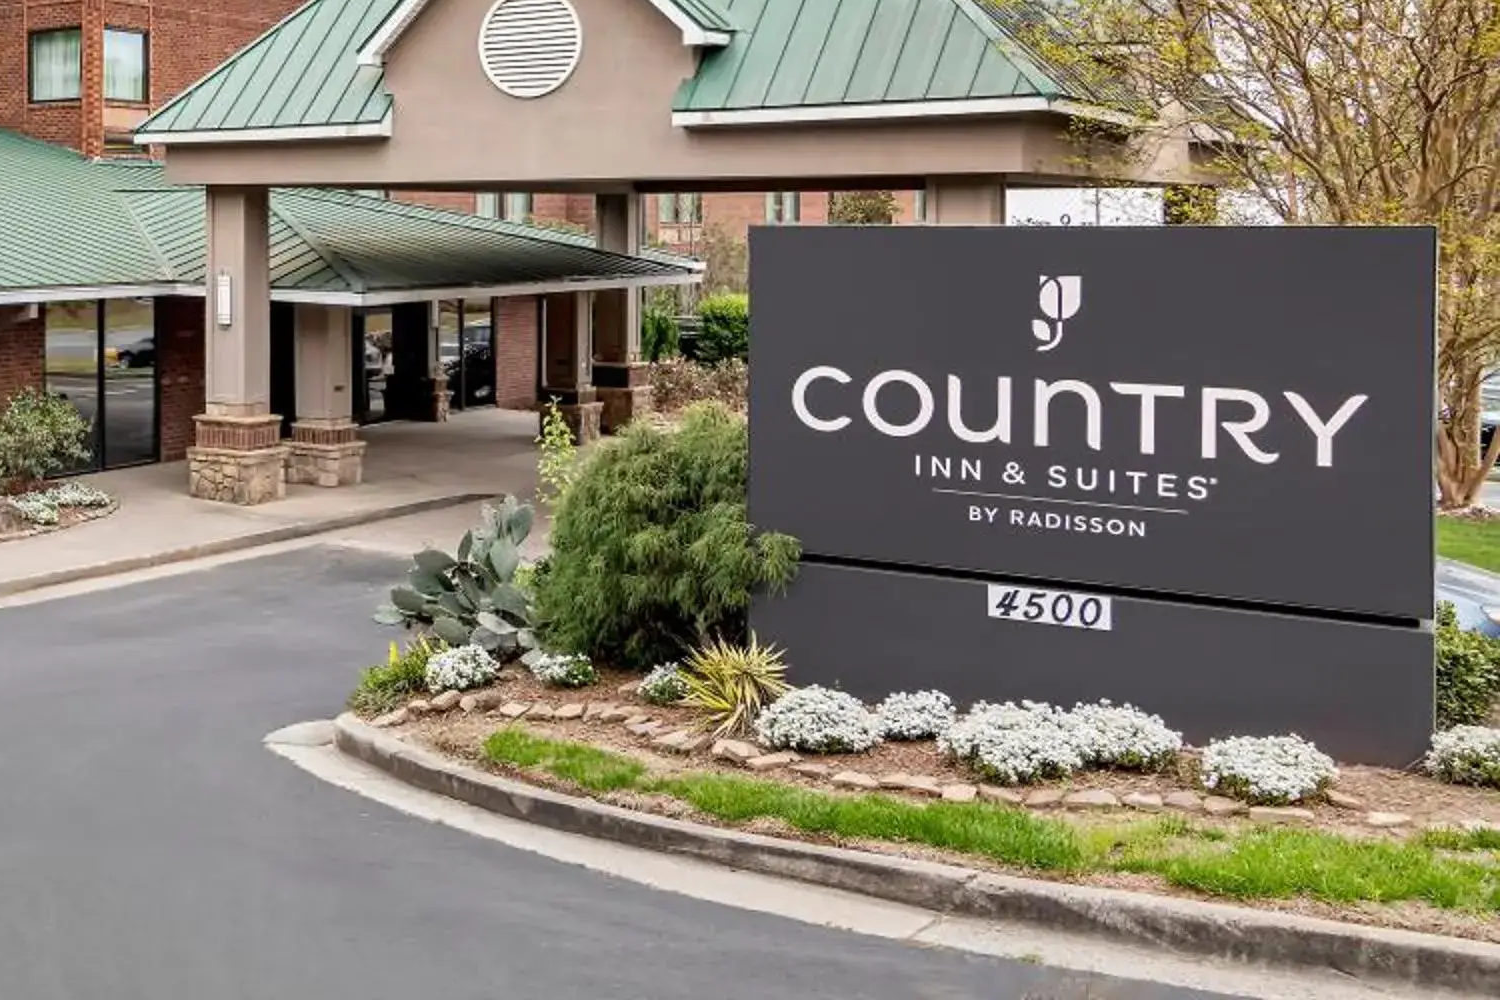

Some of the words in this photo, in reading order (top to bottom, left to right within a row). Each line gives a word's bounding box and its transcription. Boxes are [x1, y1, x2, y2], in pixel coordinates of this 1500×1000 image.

[915, 454, 982, 481] INN
[1002, 461, 1026, 485] &
[969, 505, 999, 523] BY
[1010, 509, 1146, 537] RADISSON
[996, 589, 1102, 627] 4500
